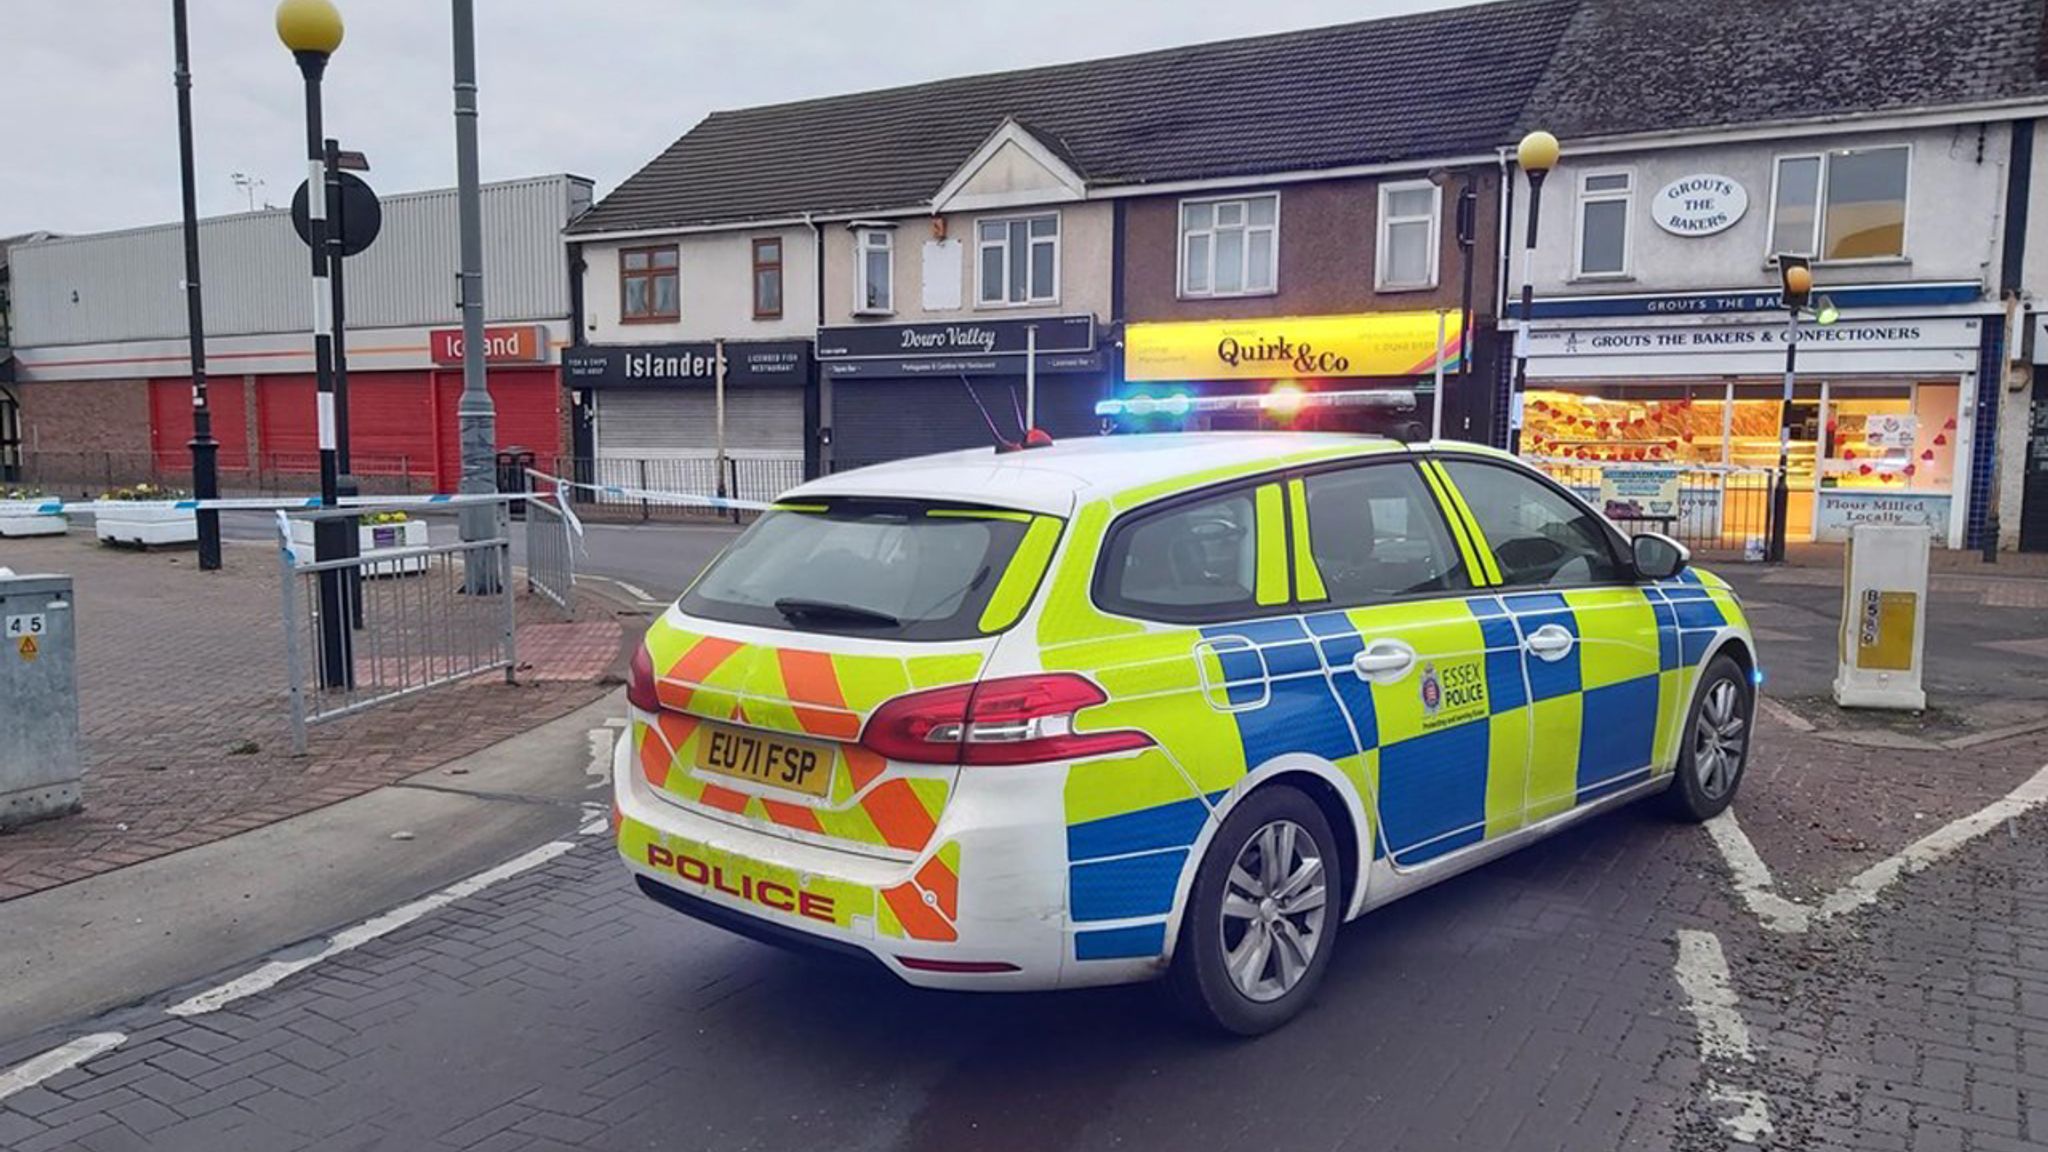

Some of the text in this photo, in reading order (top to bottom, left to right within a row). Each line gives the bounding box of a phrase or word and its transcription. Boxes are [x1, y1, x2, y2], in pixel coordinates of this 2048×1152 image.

[1667, 180, 1733, 198] GROUTS
[1684, 199, 1714, 211] THE
[1669, 212, 1728, 230] BAKERS
[1647, 299, 1707, 312] GROUTS
[1717, 298, 1745, 309] THE
[446, 332, 519, 357] Icand
[901, 327, 996, 352] Douro Valley
[1592, 334, 1651, 347] GROUTS
[1657, 333, 1687, 346] THE
[1693, 331, 1755, 345] BAKERS
[1761, 331, 1774, 343] &
[1826, 499, 1868, 510] Flour
[1846, 511, 1903, 521] Locally
[1443, 662, 1482, 688] ESSEX
[1445, 683, 1484, 708] POLICE
[648, 843, 836, 923] POLICE
